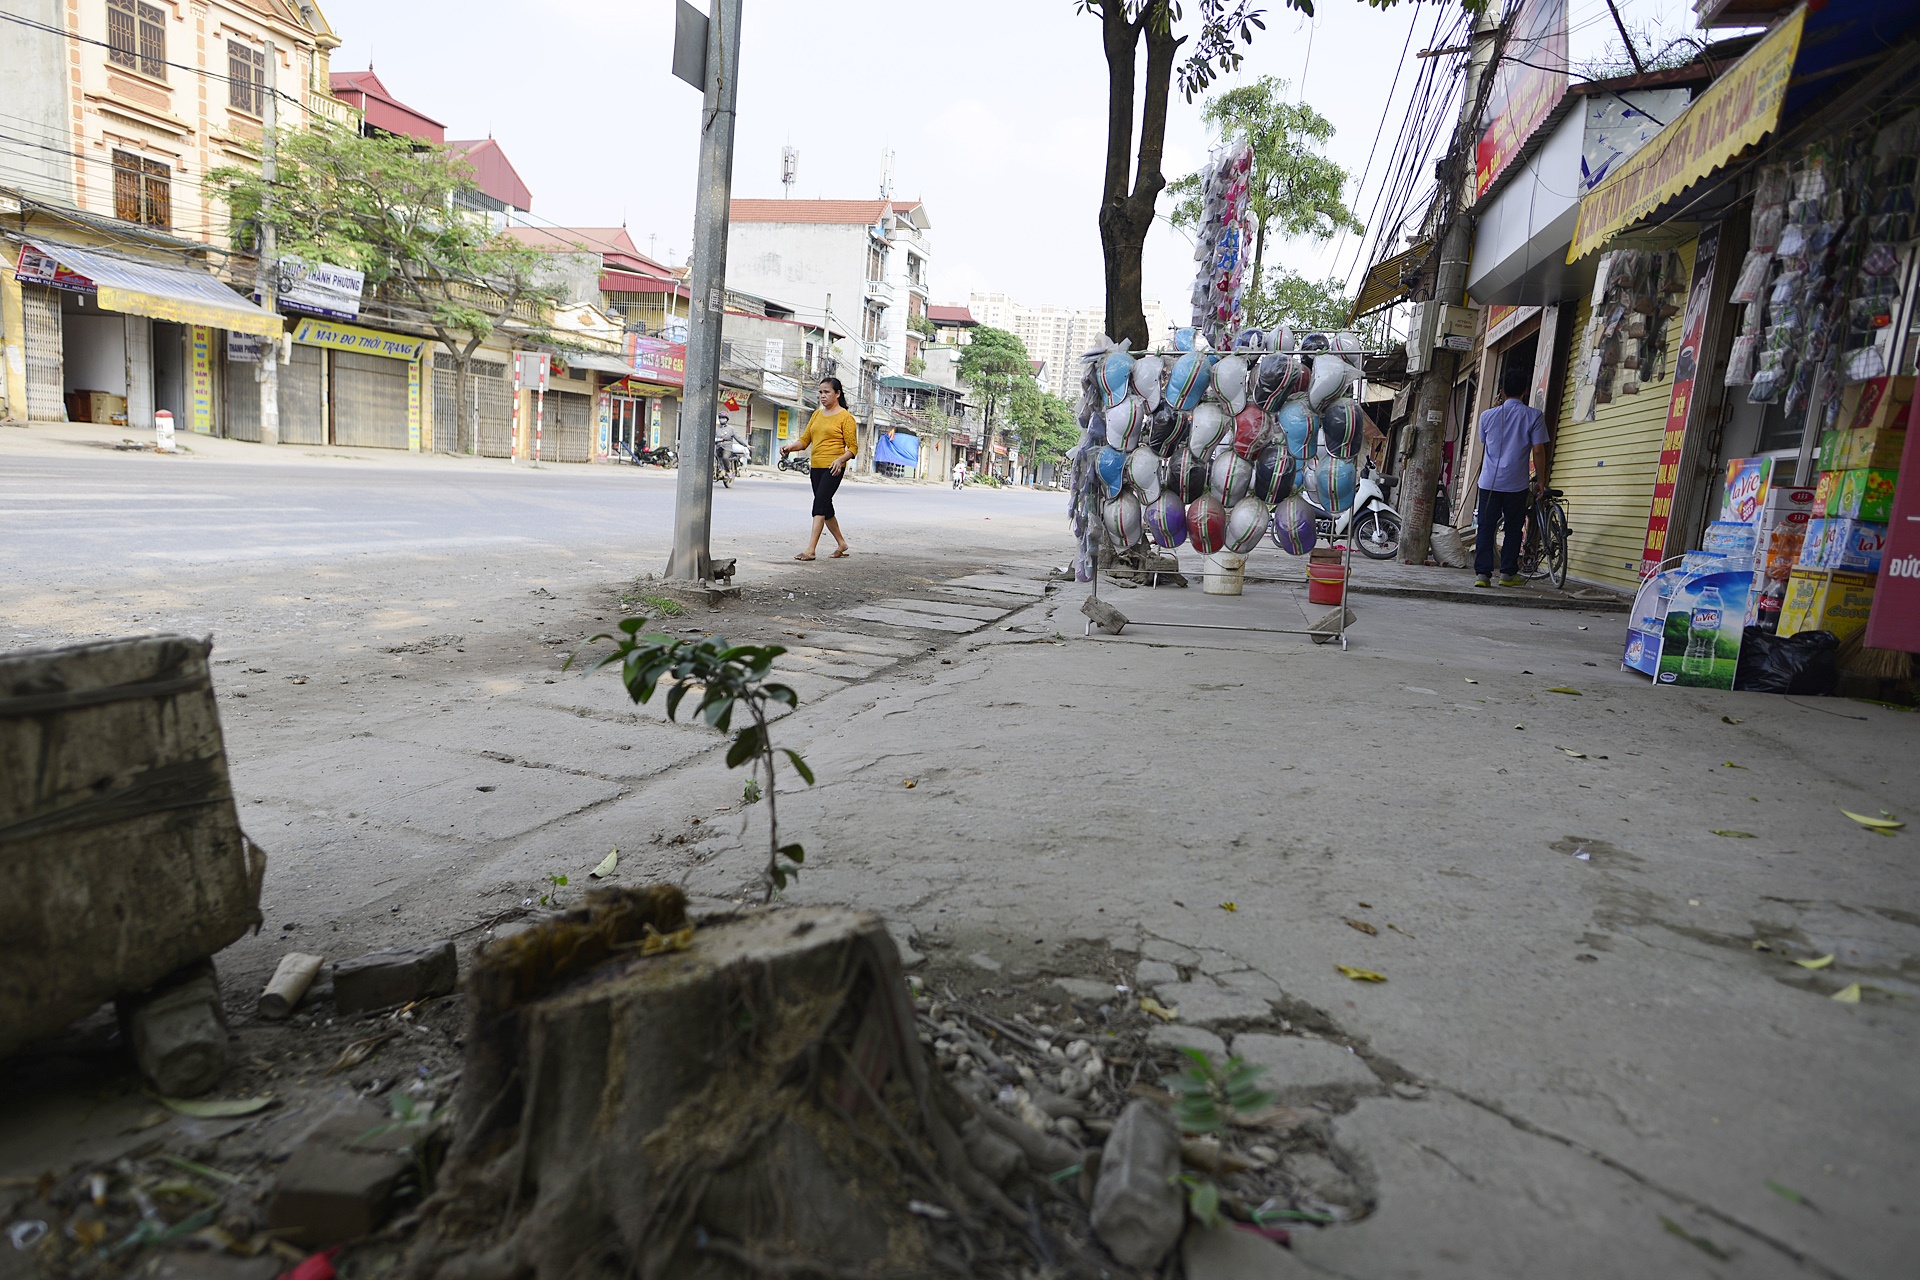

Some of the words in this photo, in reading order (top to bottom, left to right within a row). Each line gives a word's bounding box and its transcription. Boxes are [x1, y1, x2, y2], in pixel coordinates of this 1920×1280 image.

[314, 330, 340, 341] MAY
[340, 333, 356, 345] ĐO
[358, 336, 381, 349] THỜI
[383, 341, 412, 354] TRANG
[1646, 525, 1658, 550] NHÀ
